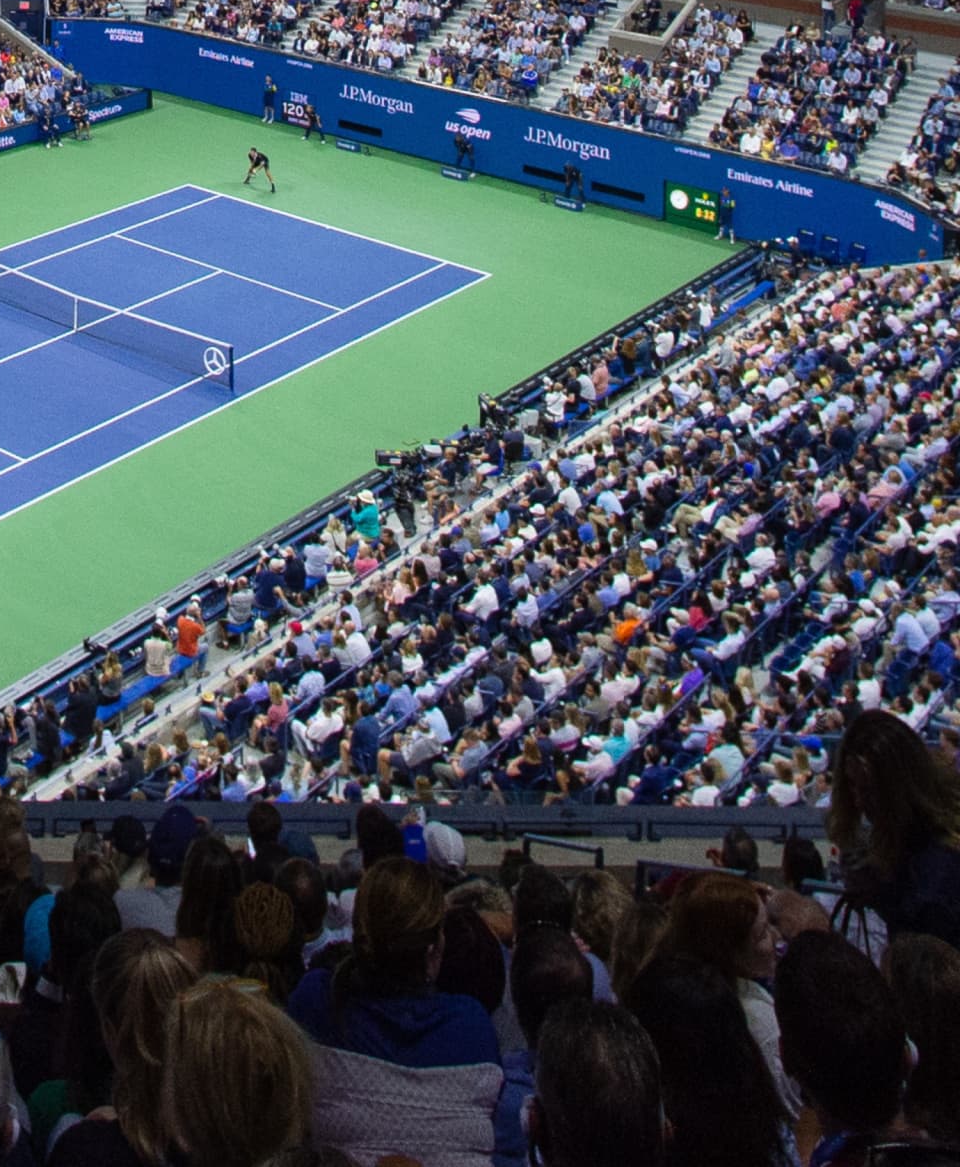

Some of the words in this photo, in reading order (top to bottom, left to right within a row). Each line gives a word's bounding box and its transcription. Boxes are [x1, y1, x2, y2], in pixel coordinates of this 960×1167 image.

[104, 27, 144, 37] AMERICAN
[109, 34, 144, 44] EXPRESS
[198, 46, 229, 62] Emirates
[230, 54, 255, 69] Airline
[290, 91, 308, 105] IBM
[339, 83, 415, 115] J.P.Morgan
[445, 120, 460, 133] us
[460, 125, 491, 141] open
[524, 126, 611, 161] J.P.Morgan
[727, 167, 774, 190] Emirates
[775, 179, 814, 198] Airline
[875, 199, 915, 224] AMERICAN
[880, 209, 916, 232] EXPRESS
